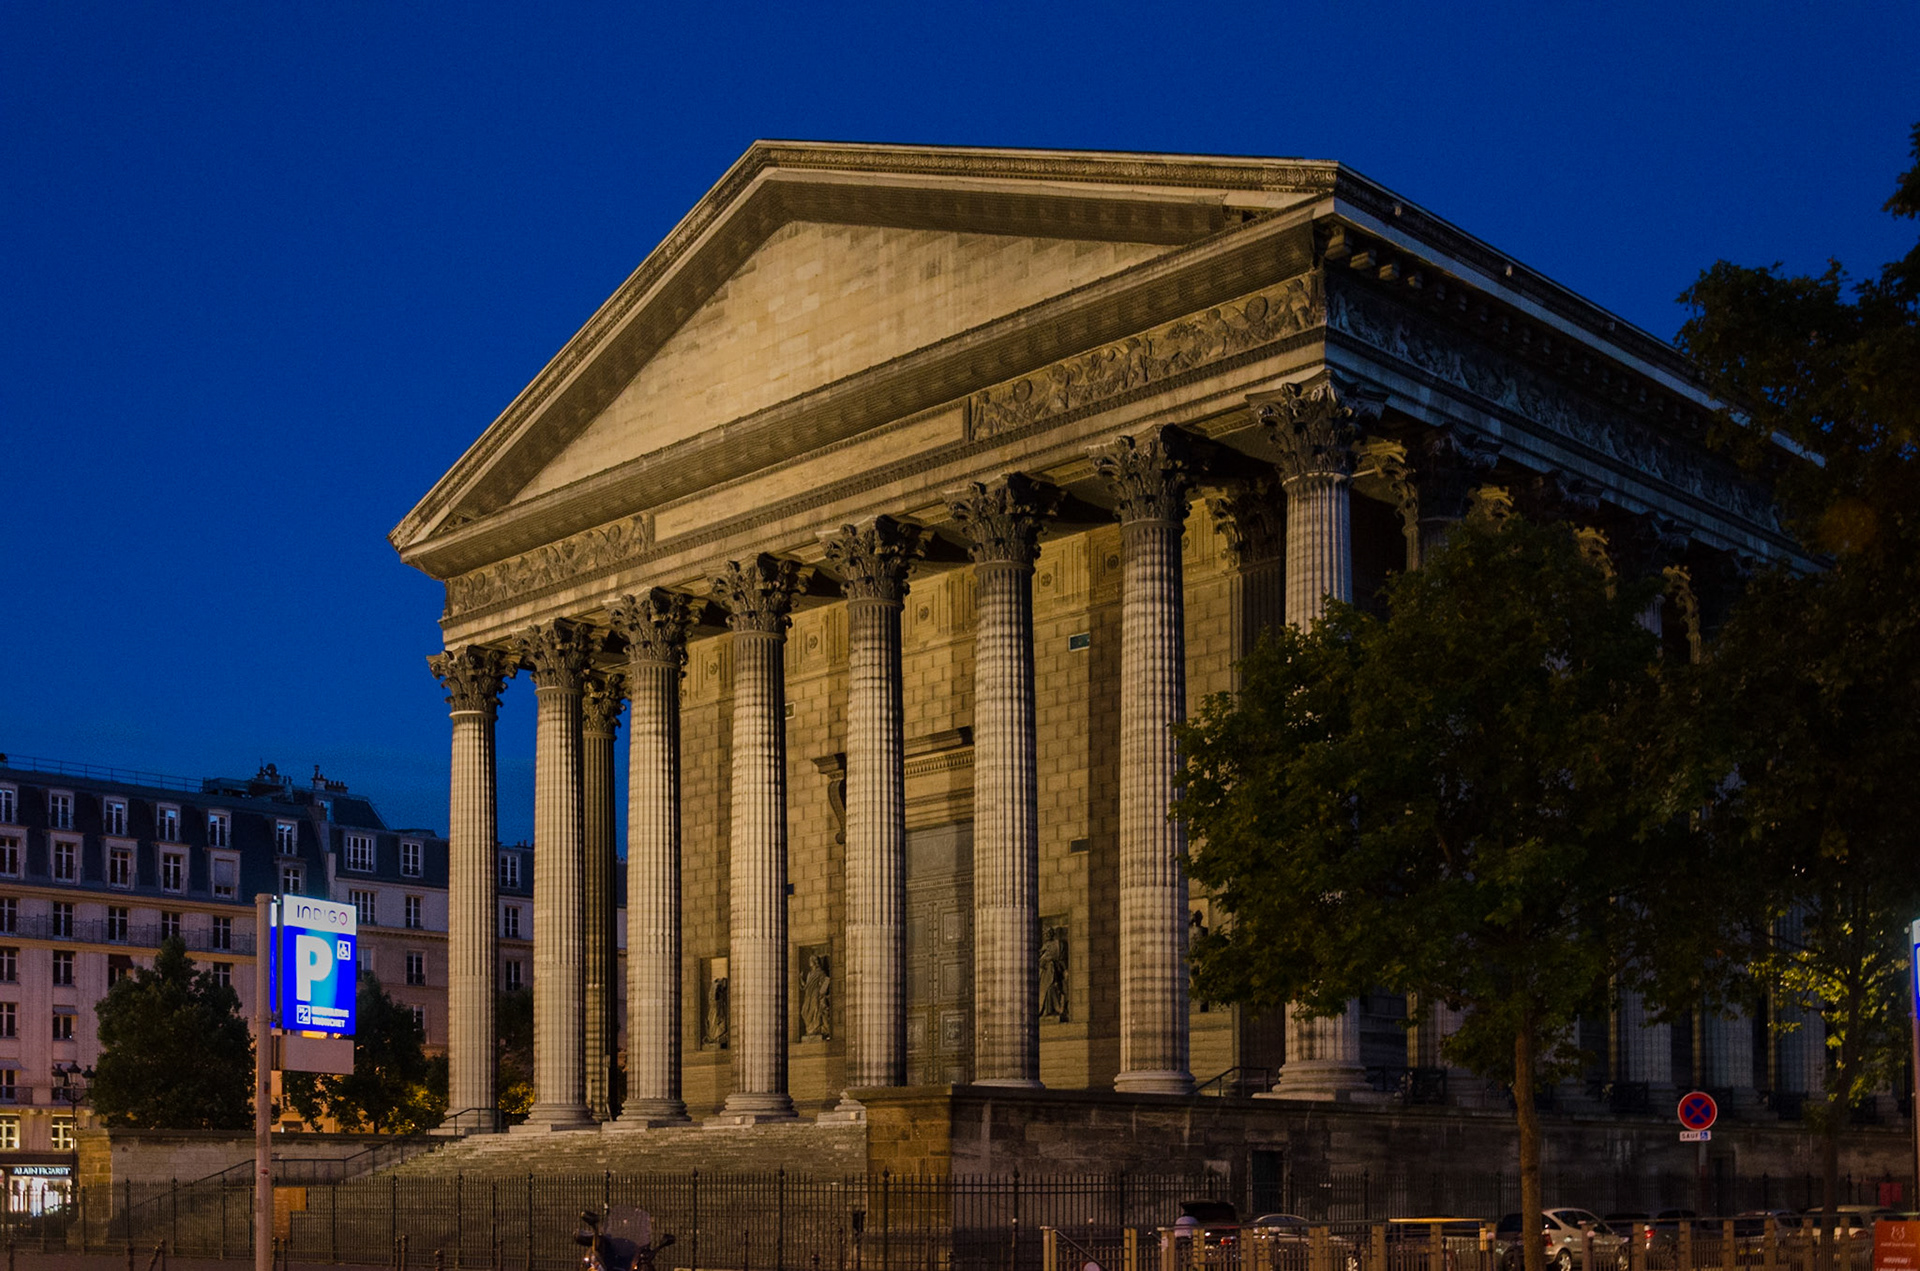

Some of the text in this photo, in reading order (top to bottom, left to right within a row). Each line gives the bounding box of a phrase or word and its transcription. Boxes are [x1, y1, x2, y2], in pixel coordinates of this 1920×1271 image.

[297, 904, 348, 926] INDIGO
[296, 934, 333, 1002] P
[14, 1166, 38, 1175] ALAIN
